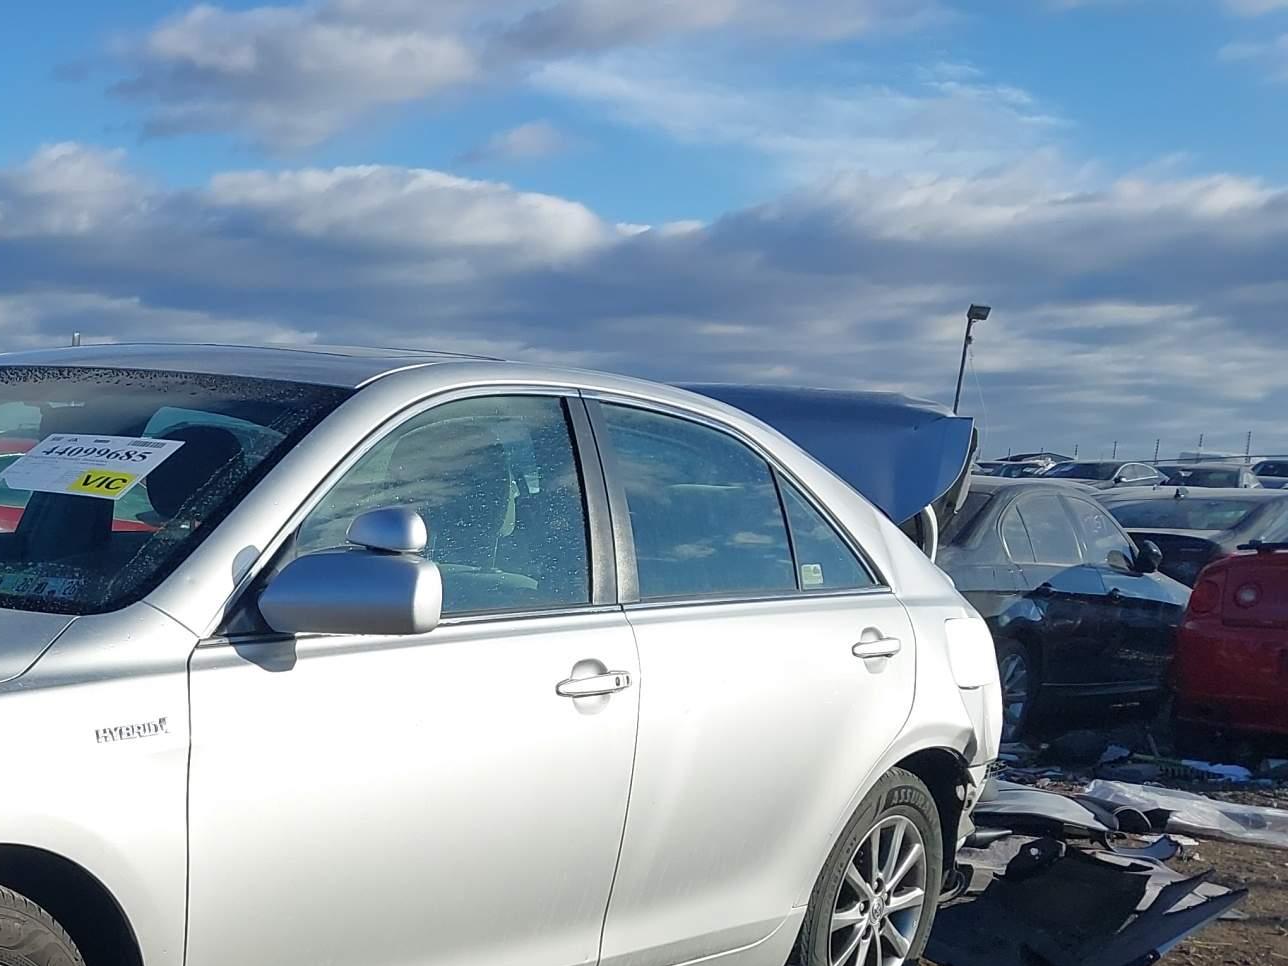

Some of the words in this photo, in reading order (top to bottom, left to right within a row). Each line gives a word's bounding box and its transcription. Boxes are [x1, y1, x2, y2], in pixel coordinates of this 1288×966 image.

[42, 445, 153, 463] 44099685
[81, 473, 128, 490] VIC
[95, 722, 159, 744] HYBRID
